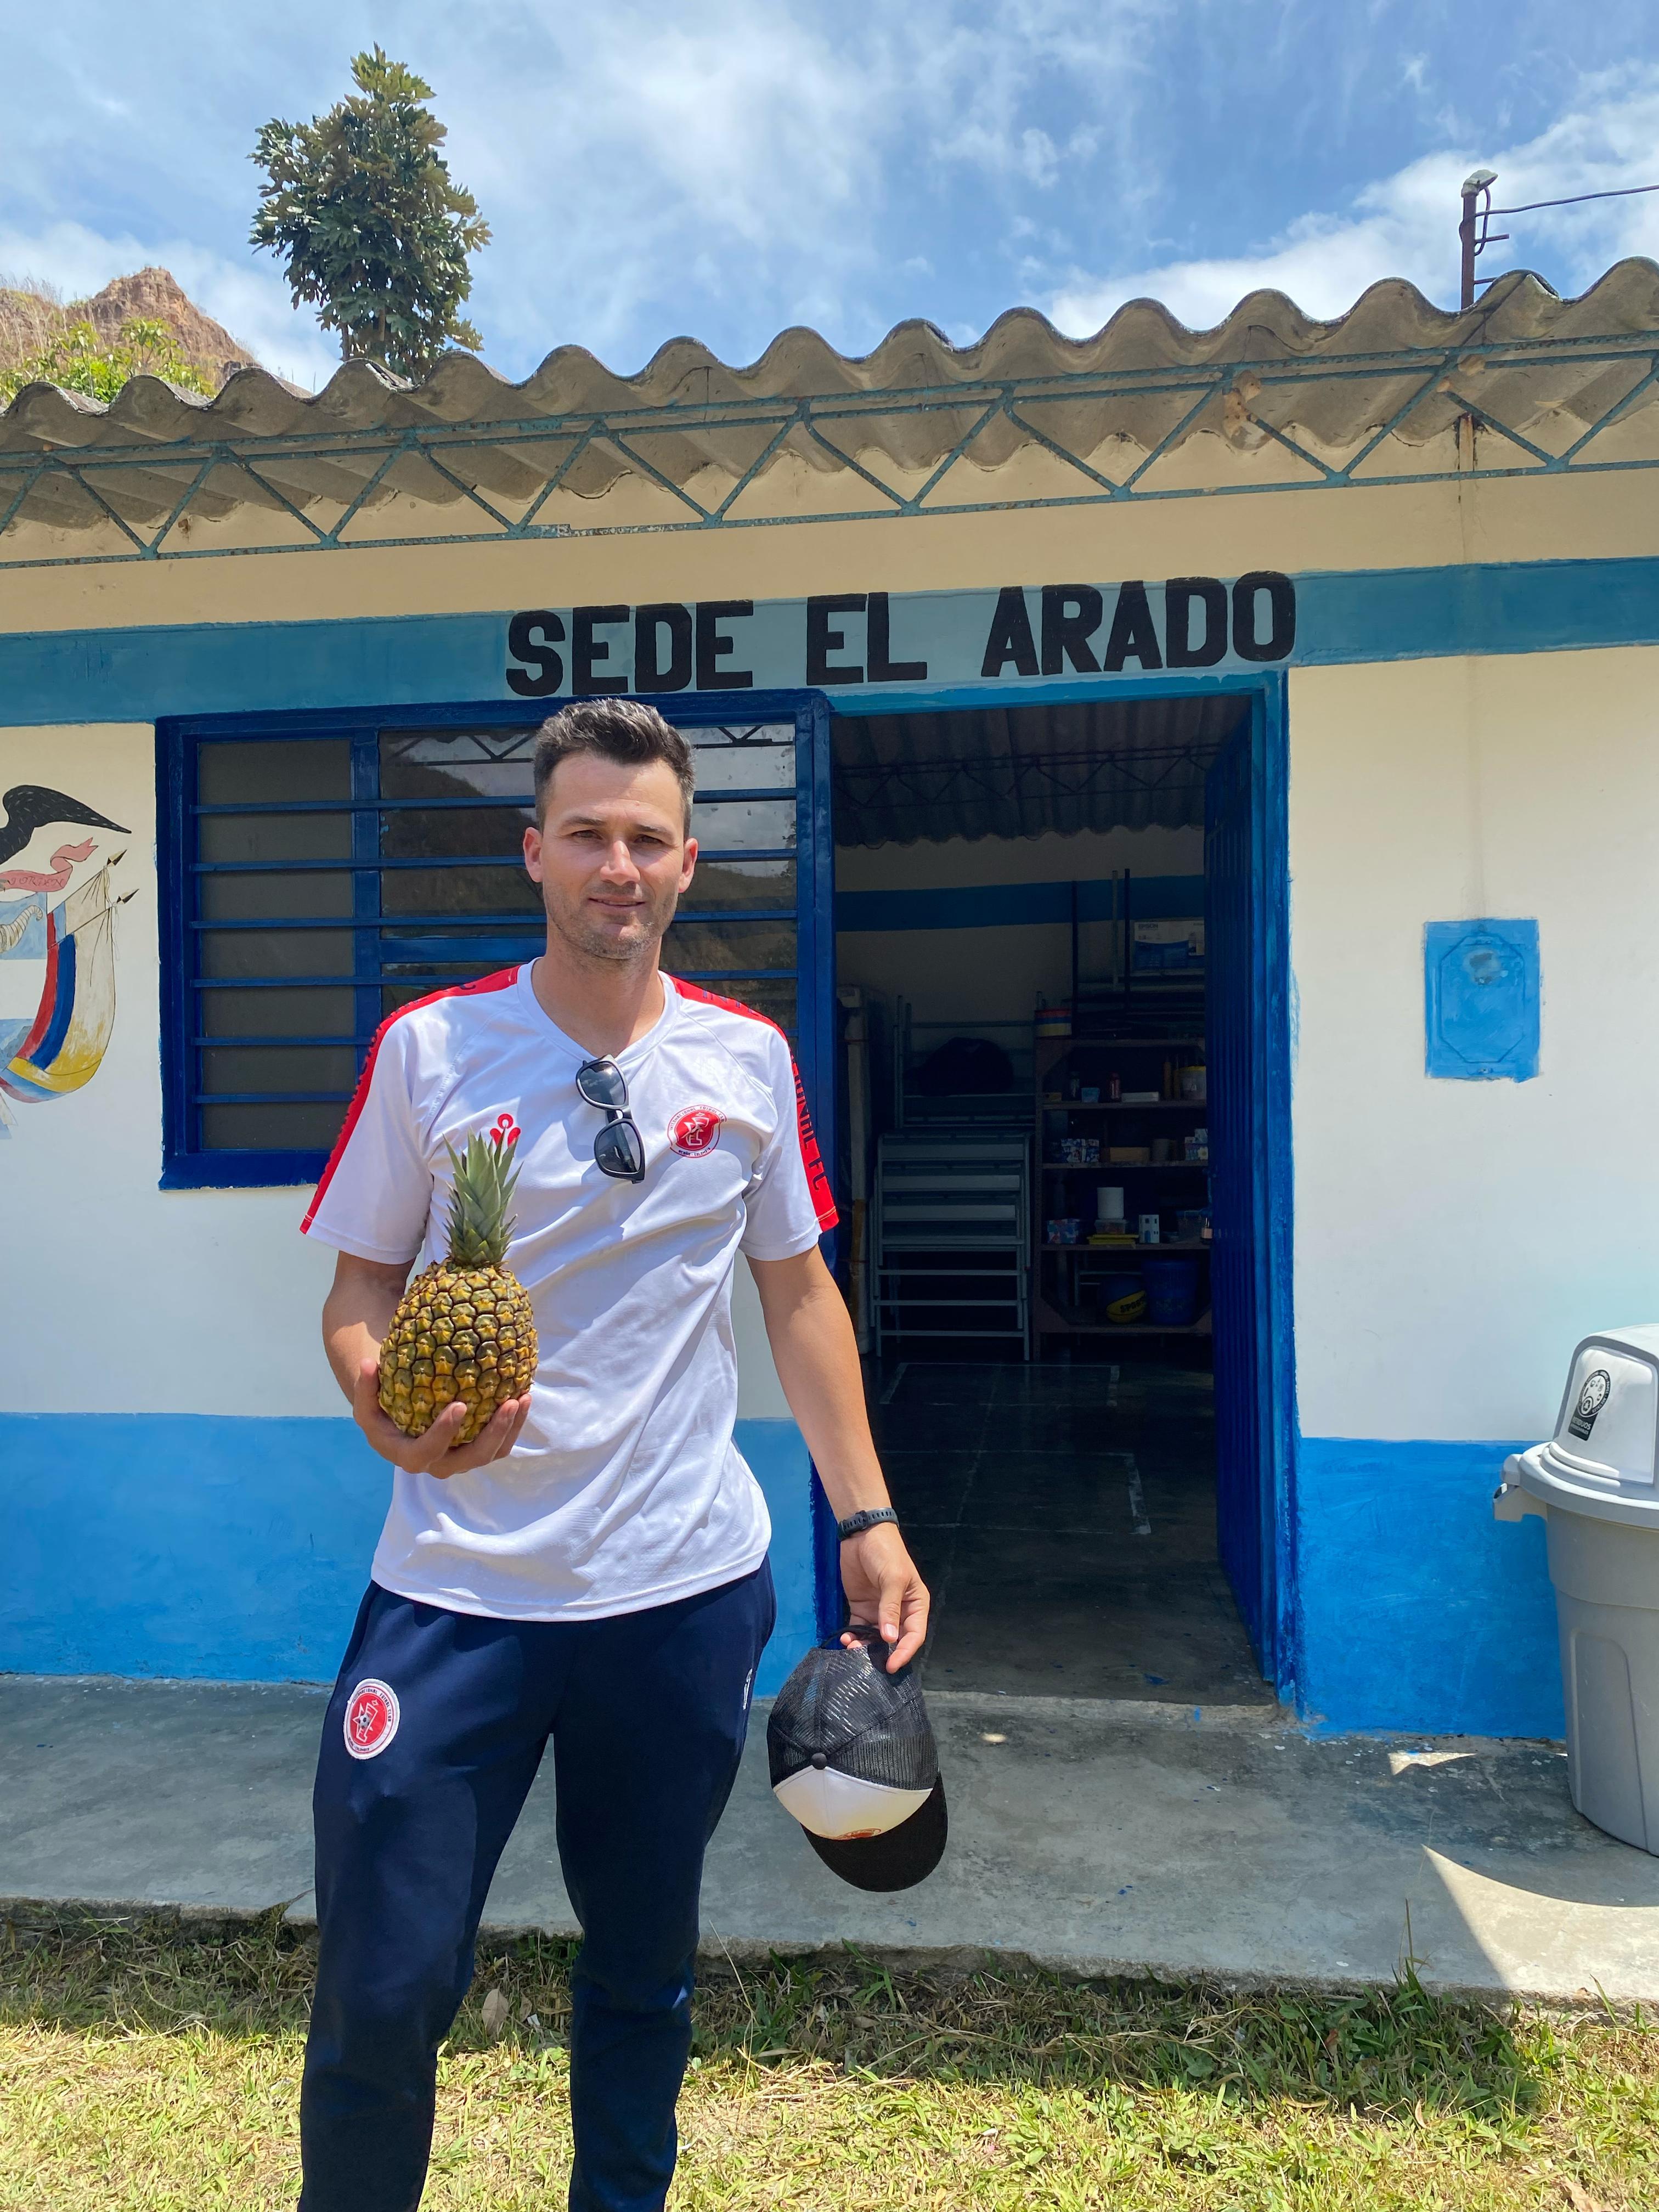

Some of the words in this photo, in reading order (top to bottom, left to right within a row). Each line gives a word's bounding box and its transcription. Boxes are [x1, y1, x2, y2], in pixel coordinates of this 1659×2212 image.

[506, 599, 754, 698] SEDE
[806, 591, 928, 686] EL
[980, 571, 1296, 678] ARADO
